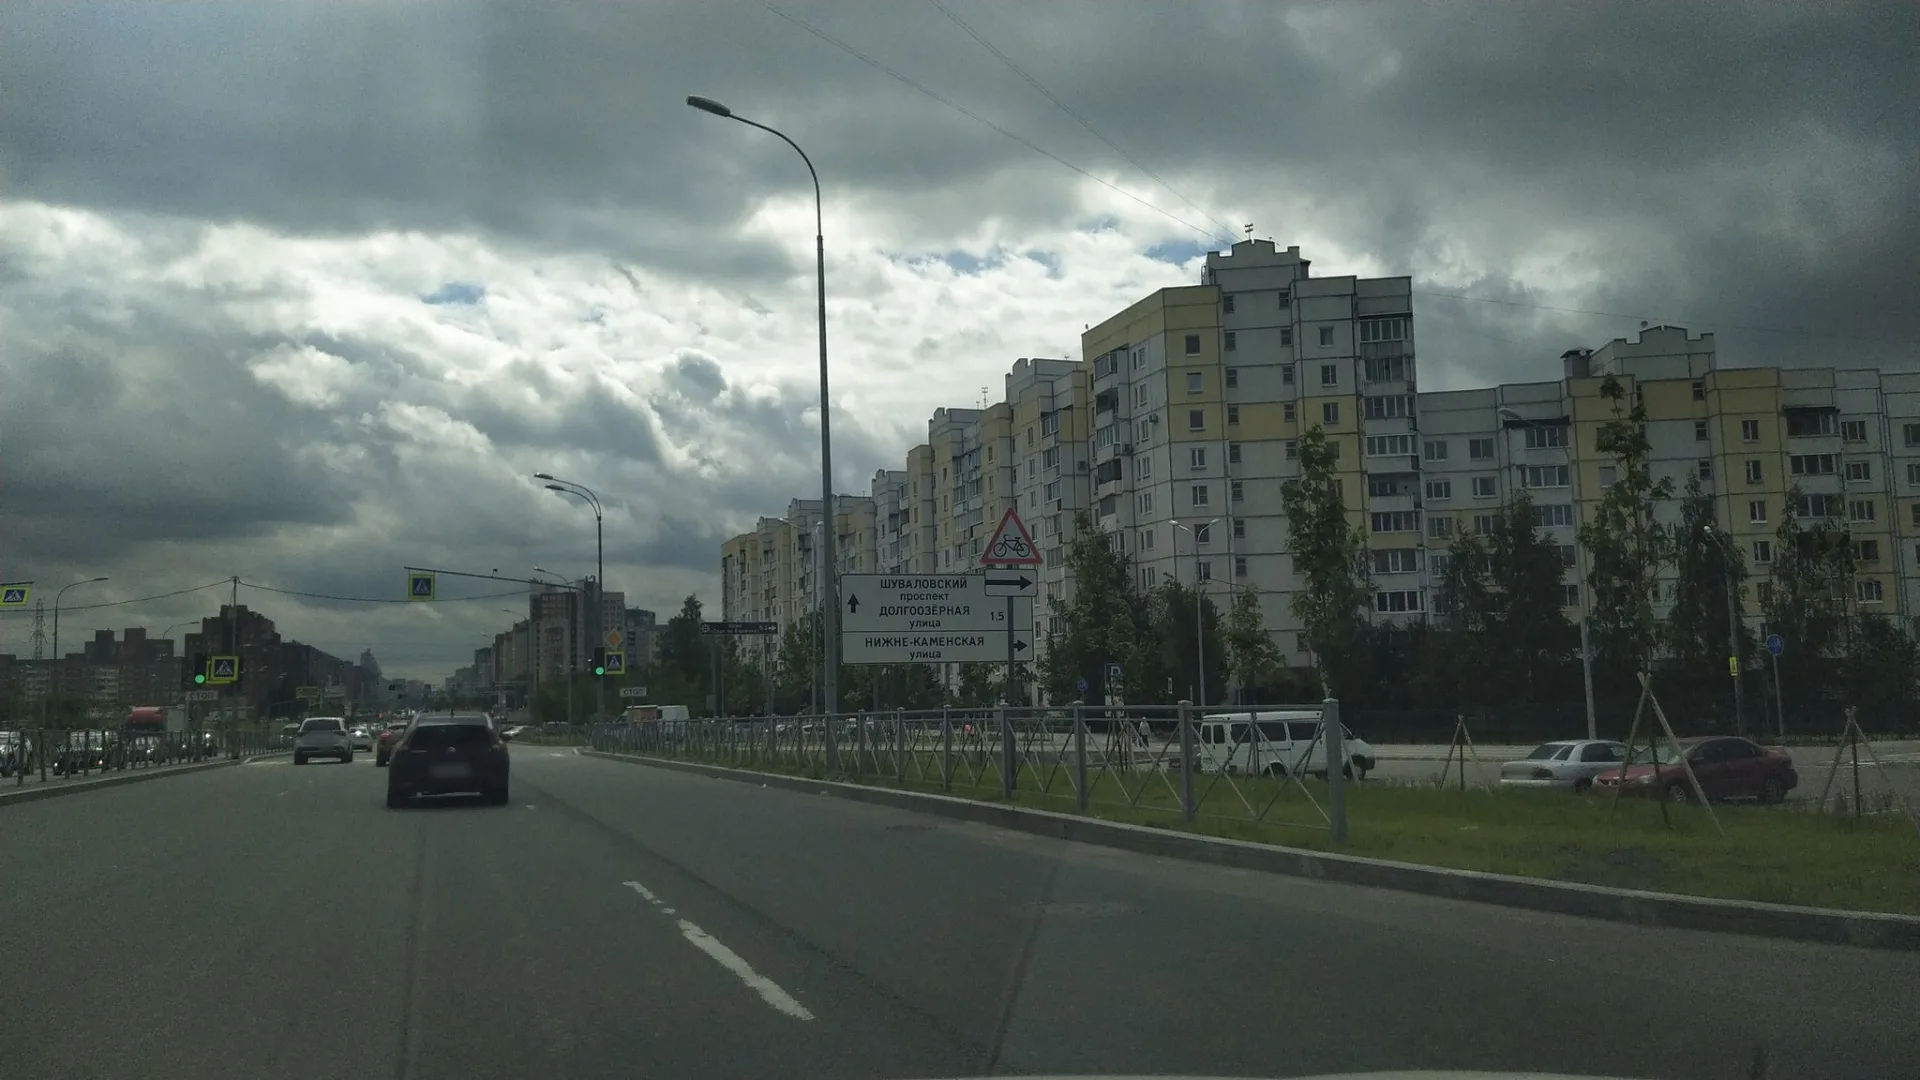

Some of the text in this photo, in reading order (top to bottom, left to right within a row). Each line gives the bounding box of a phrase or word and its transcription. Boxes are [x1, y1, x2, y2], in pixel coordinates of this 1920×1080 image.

[880, 578, 968, 589] ШУВАЛОВСКИЙ
[900, 591, 950, 602] проспект
[879, 605, 969, 618] ДОЛГООЗЁРНАЯ
[909, 618, 941, 629] улица
[865, 636, 985, 648] НИЖНЕ-КАМЕНСКАЯ
[909, 649, 942, 660] улица
